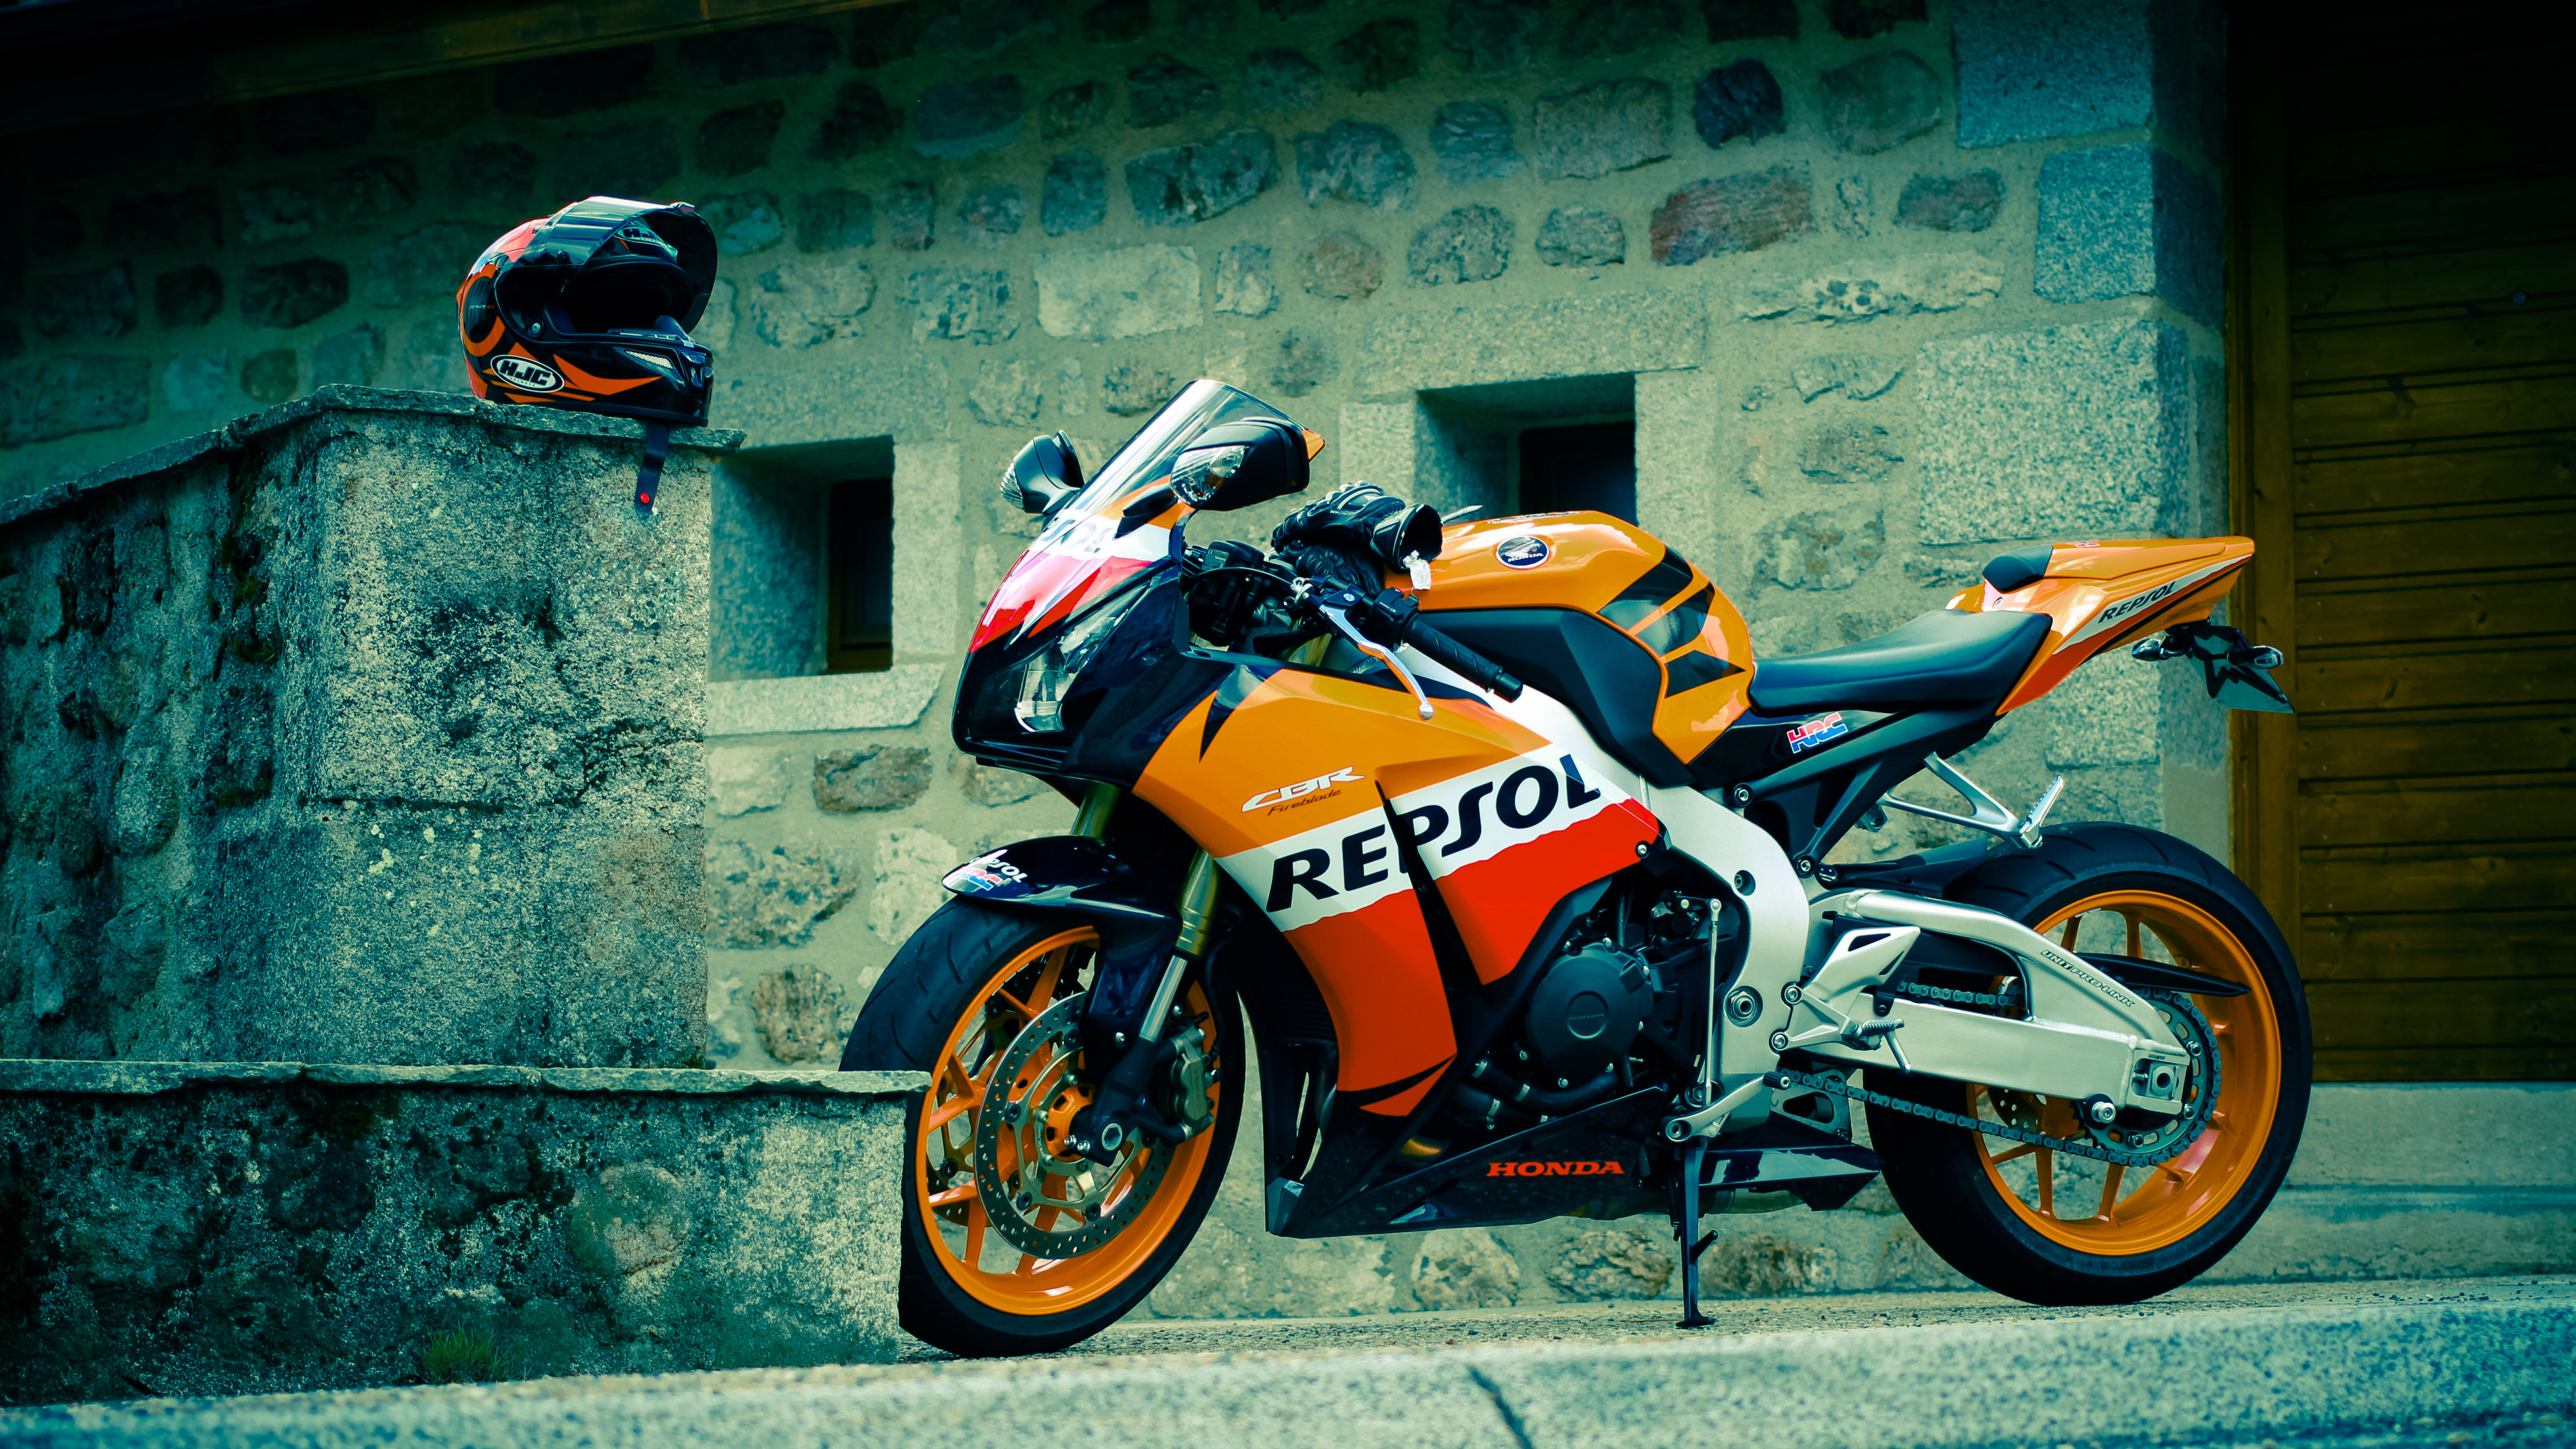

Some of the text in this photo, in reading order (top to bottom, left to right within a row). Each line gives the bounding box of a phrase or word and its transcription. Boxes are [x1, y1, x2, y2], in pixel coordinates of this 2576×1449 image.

[499, 360, 551, 386] HJC
[1507, 552, 1544, 563] HONDA
[2097, 581, 2176, 624] REPSOL
[1786, 712, 1848, 754] HRC
[1242, 765, 1366, 812] CBR
[1267, 789, 1342, 816] Fireblade
[1266, 753, 1601, 913] REPSOL
[2040, 949, 2136, 1008] UNIT PRO-LINK
[1487, 1161, 1625, 1177] HONDA
